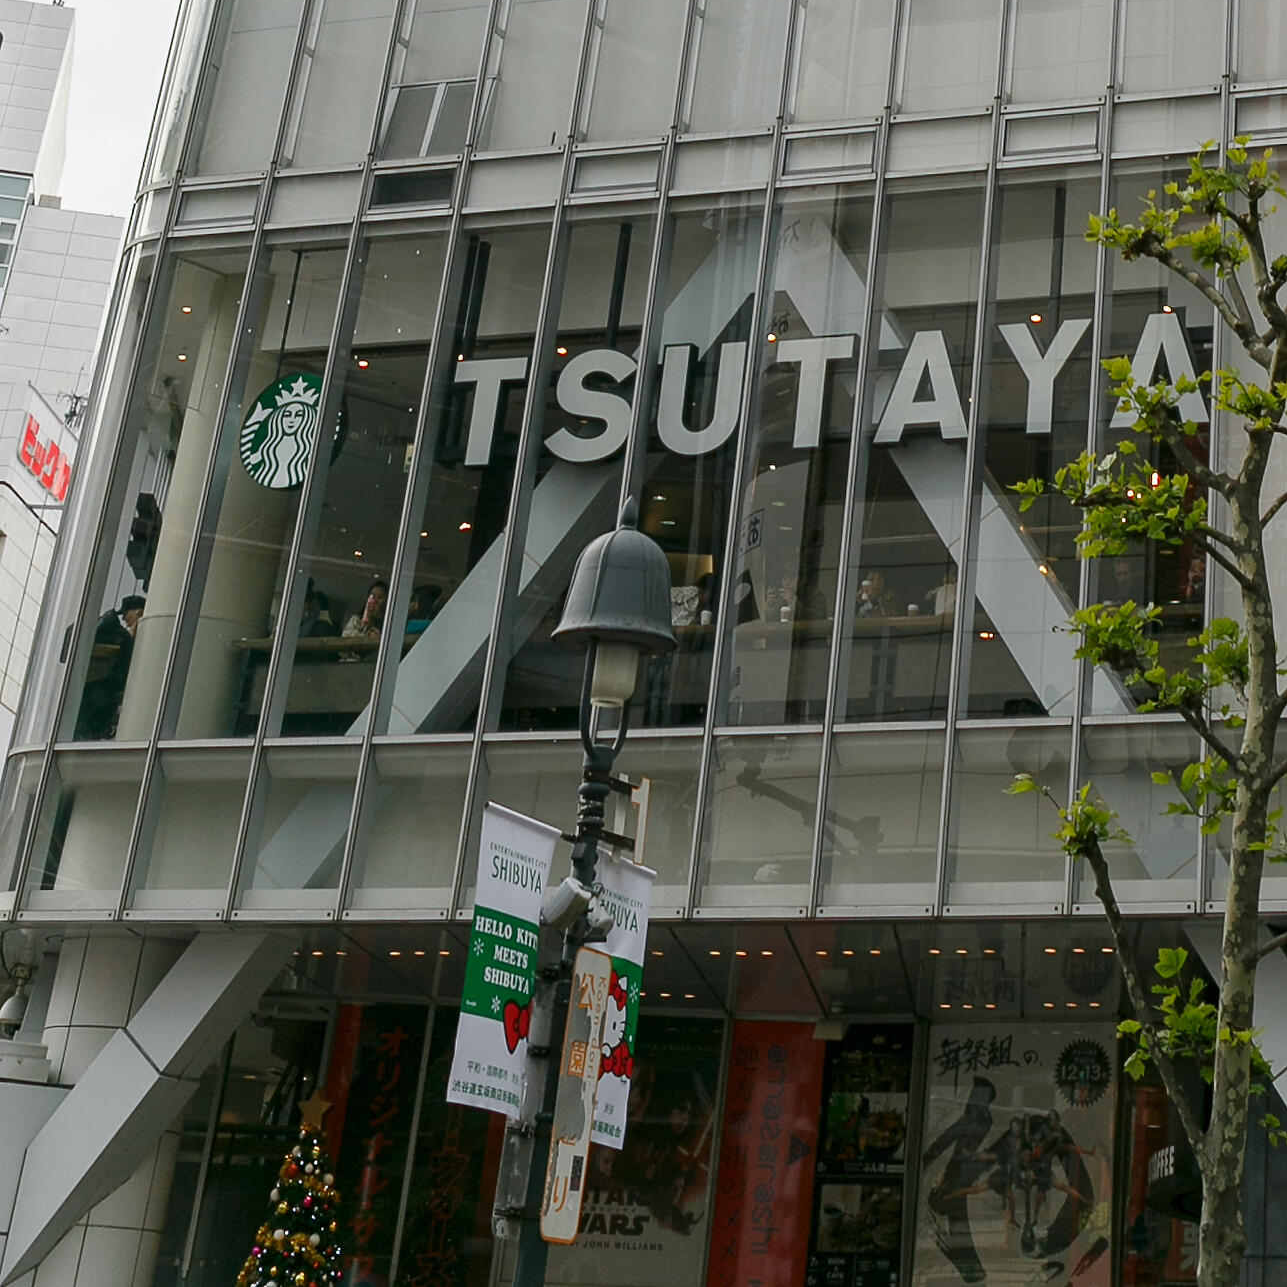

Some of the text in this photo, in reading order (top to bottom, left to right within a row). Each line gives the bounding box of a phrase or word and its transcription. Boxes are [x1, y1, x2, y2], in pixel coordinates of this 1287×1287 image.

[455, 313, 1210, 465] TSUTAYA
[490, 842, 534, 865] ENTERTAINMENT
[492, 855, 542, 895] SHIBUYA
[475, 915, 539, 952] HELLO KITT
[493, 944, 529, 969] MEETS
[484, 966, 529, 995] SHIBUYA
[614, 1241, 664, 1251] WILLIAMS
